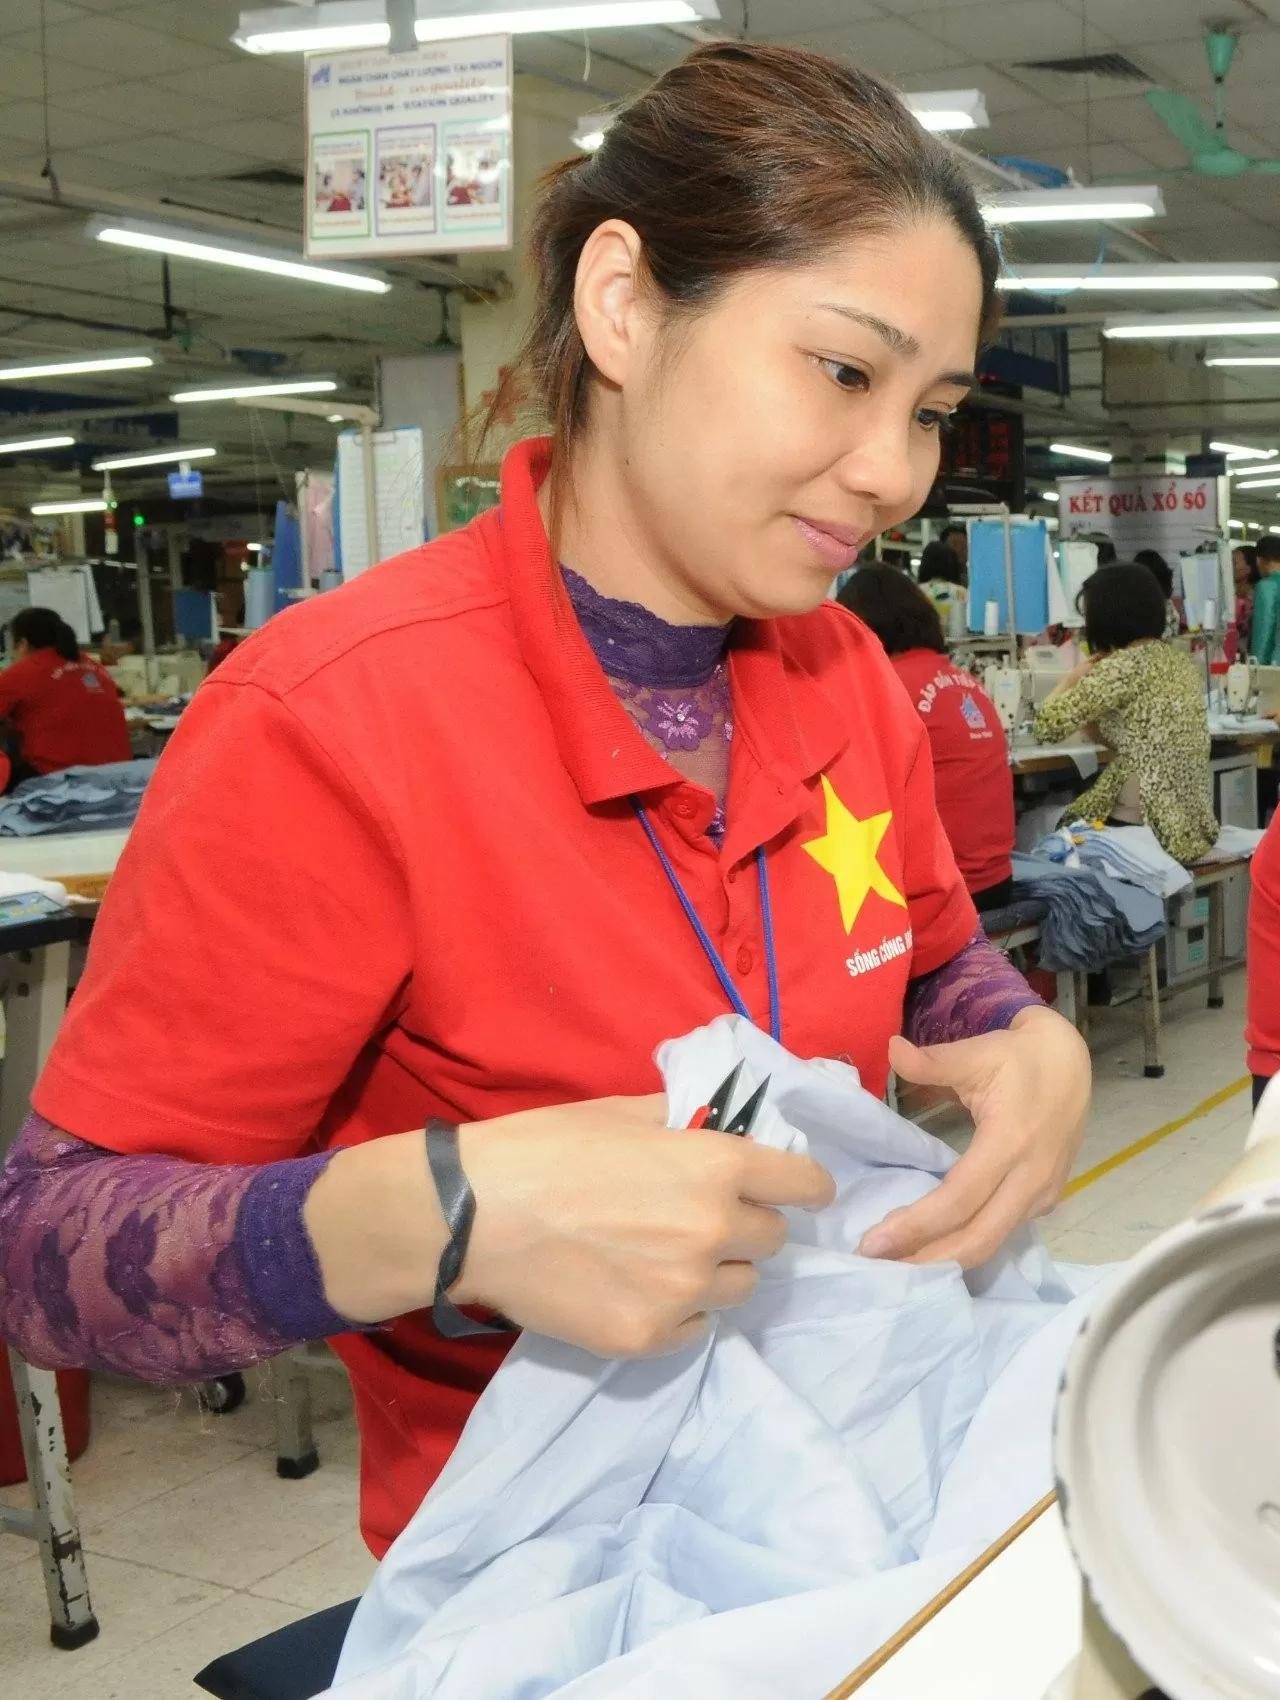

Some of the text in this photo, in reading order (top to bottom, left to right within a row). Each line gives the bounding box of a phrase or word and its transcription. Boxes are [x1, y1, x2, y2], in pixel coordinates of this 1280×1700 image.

[1069, 481, 1207, 516] KẾT QUẢ XỔ SỐ
[846, 948, 881, 977] SỐNG
[879, 935, 906, 963] CỐNG
